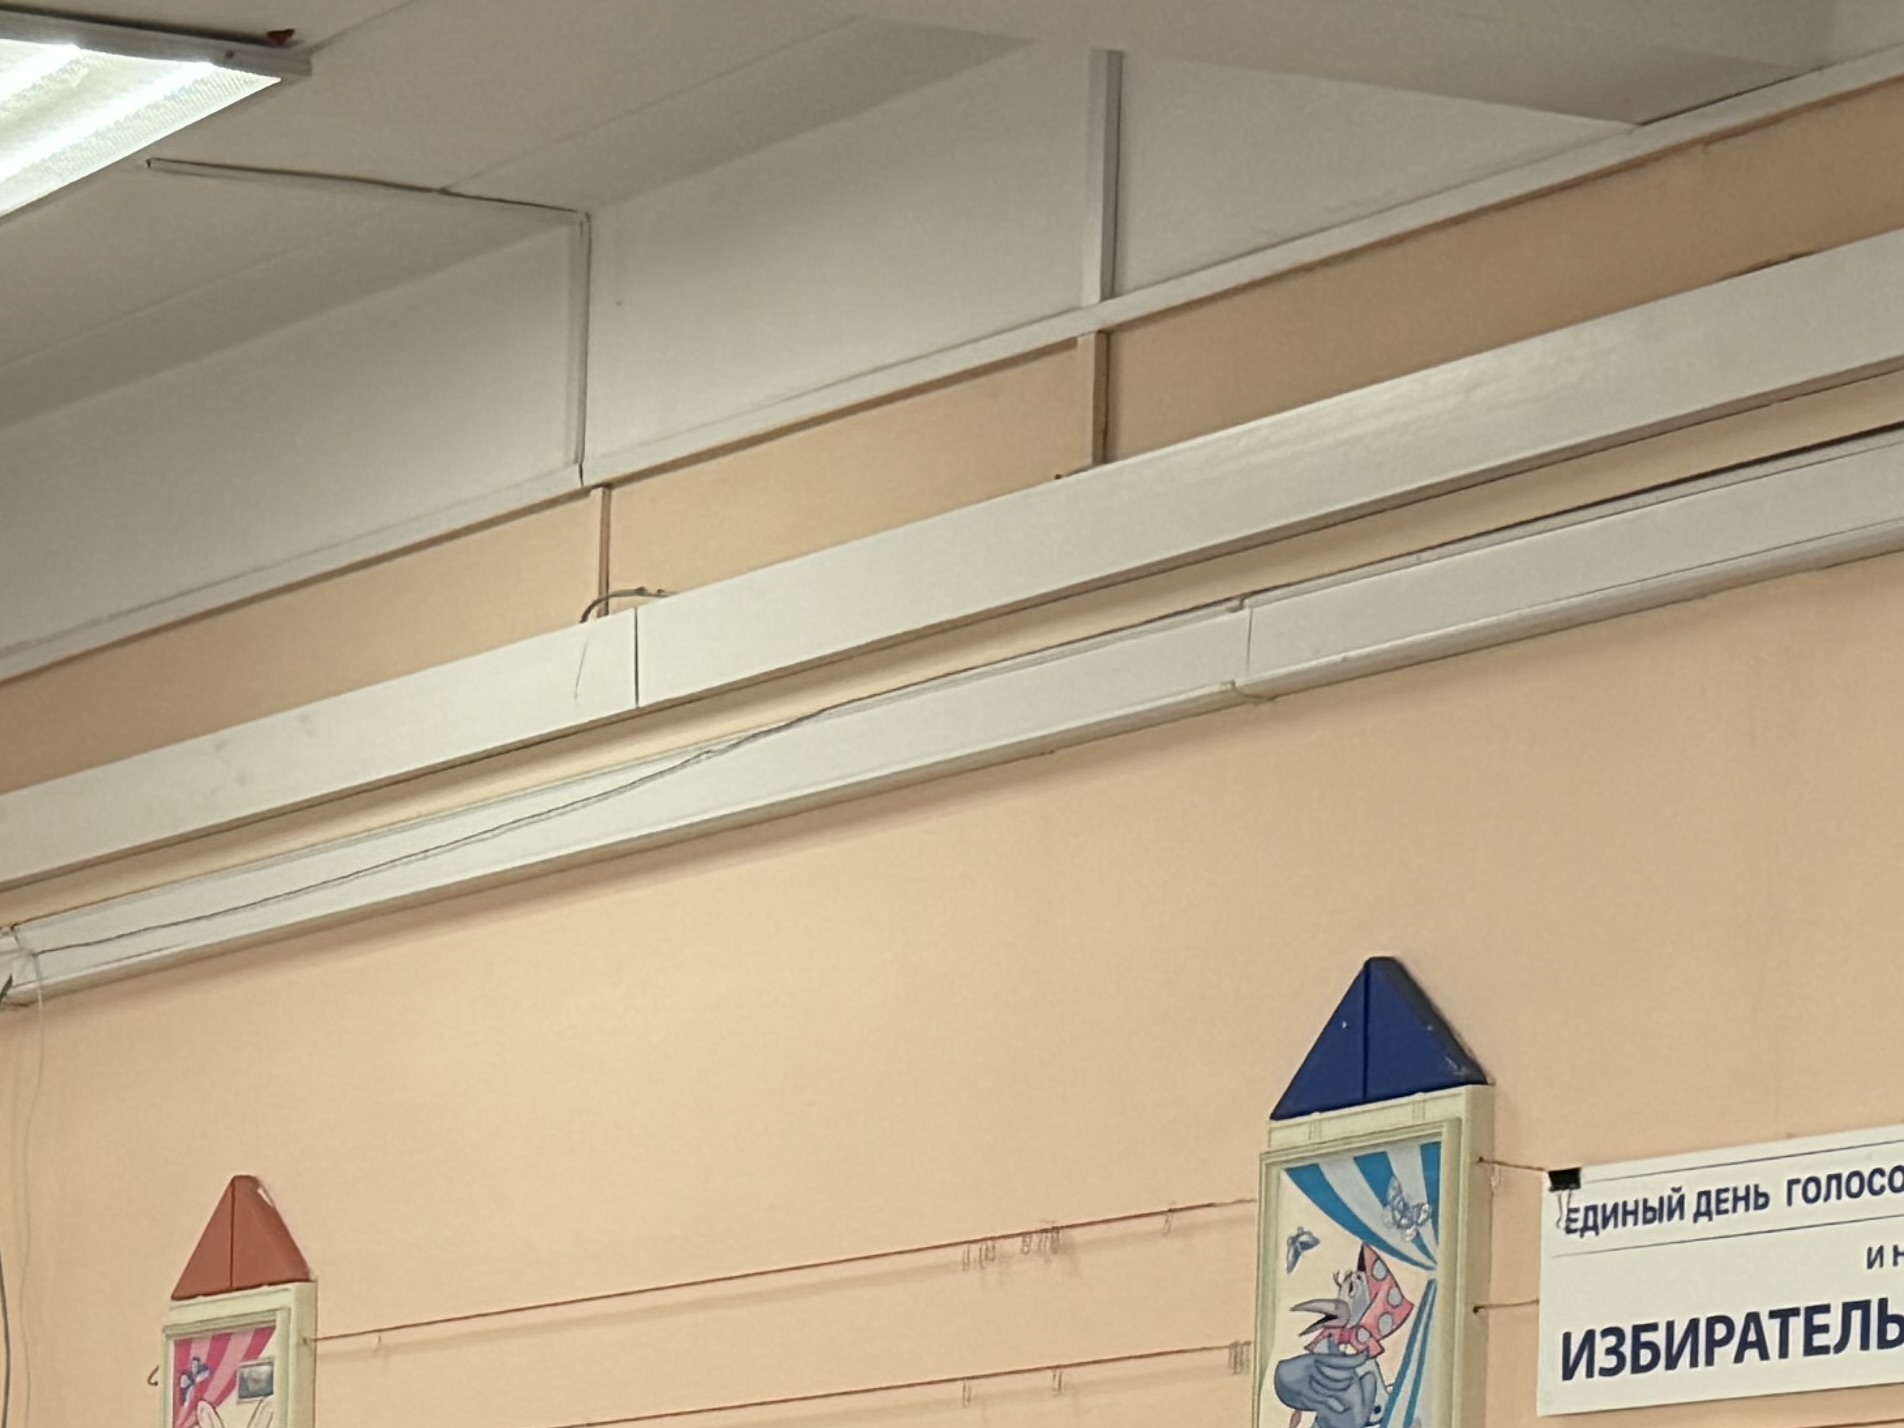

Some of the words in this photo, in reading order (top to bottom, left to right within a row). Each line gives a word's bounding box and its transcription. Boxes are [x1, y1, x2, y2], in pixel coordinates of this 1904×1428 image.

[1565, 1186, 1685, 1238] ЕДИНЫЙ
[1693, 1184, 1770, 1224] ДЕНЬ
[1786, 1164, 1904, 1207] ГОЛОСО
[1561, 1297, 1904, 1381] ИЗБИРАТЕЛЬ
